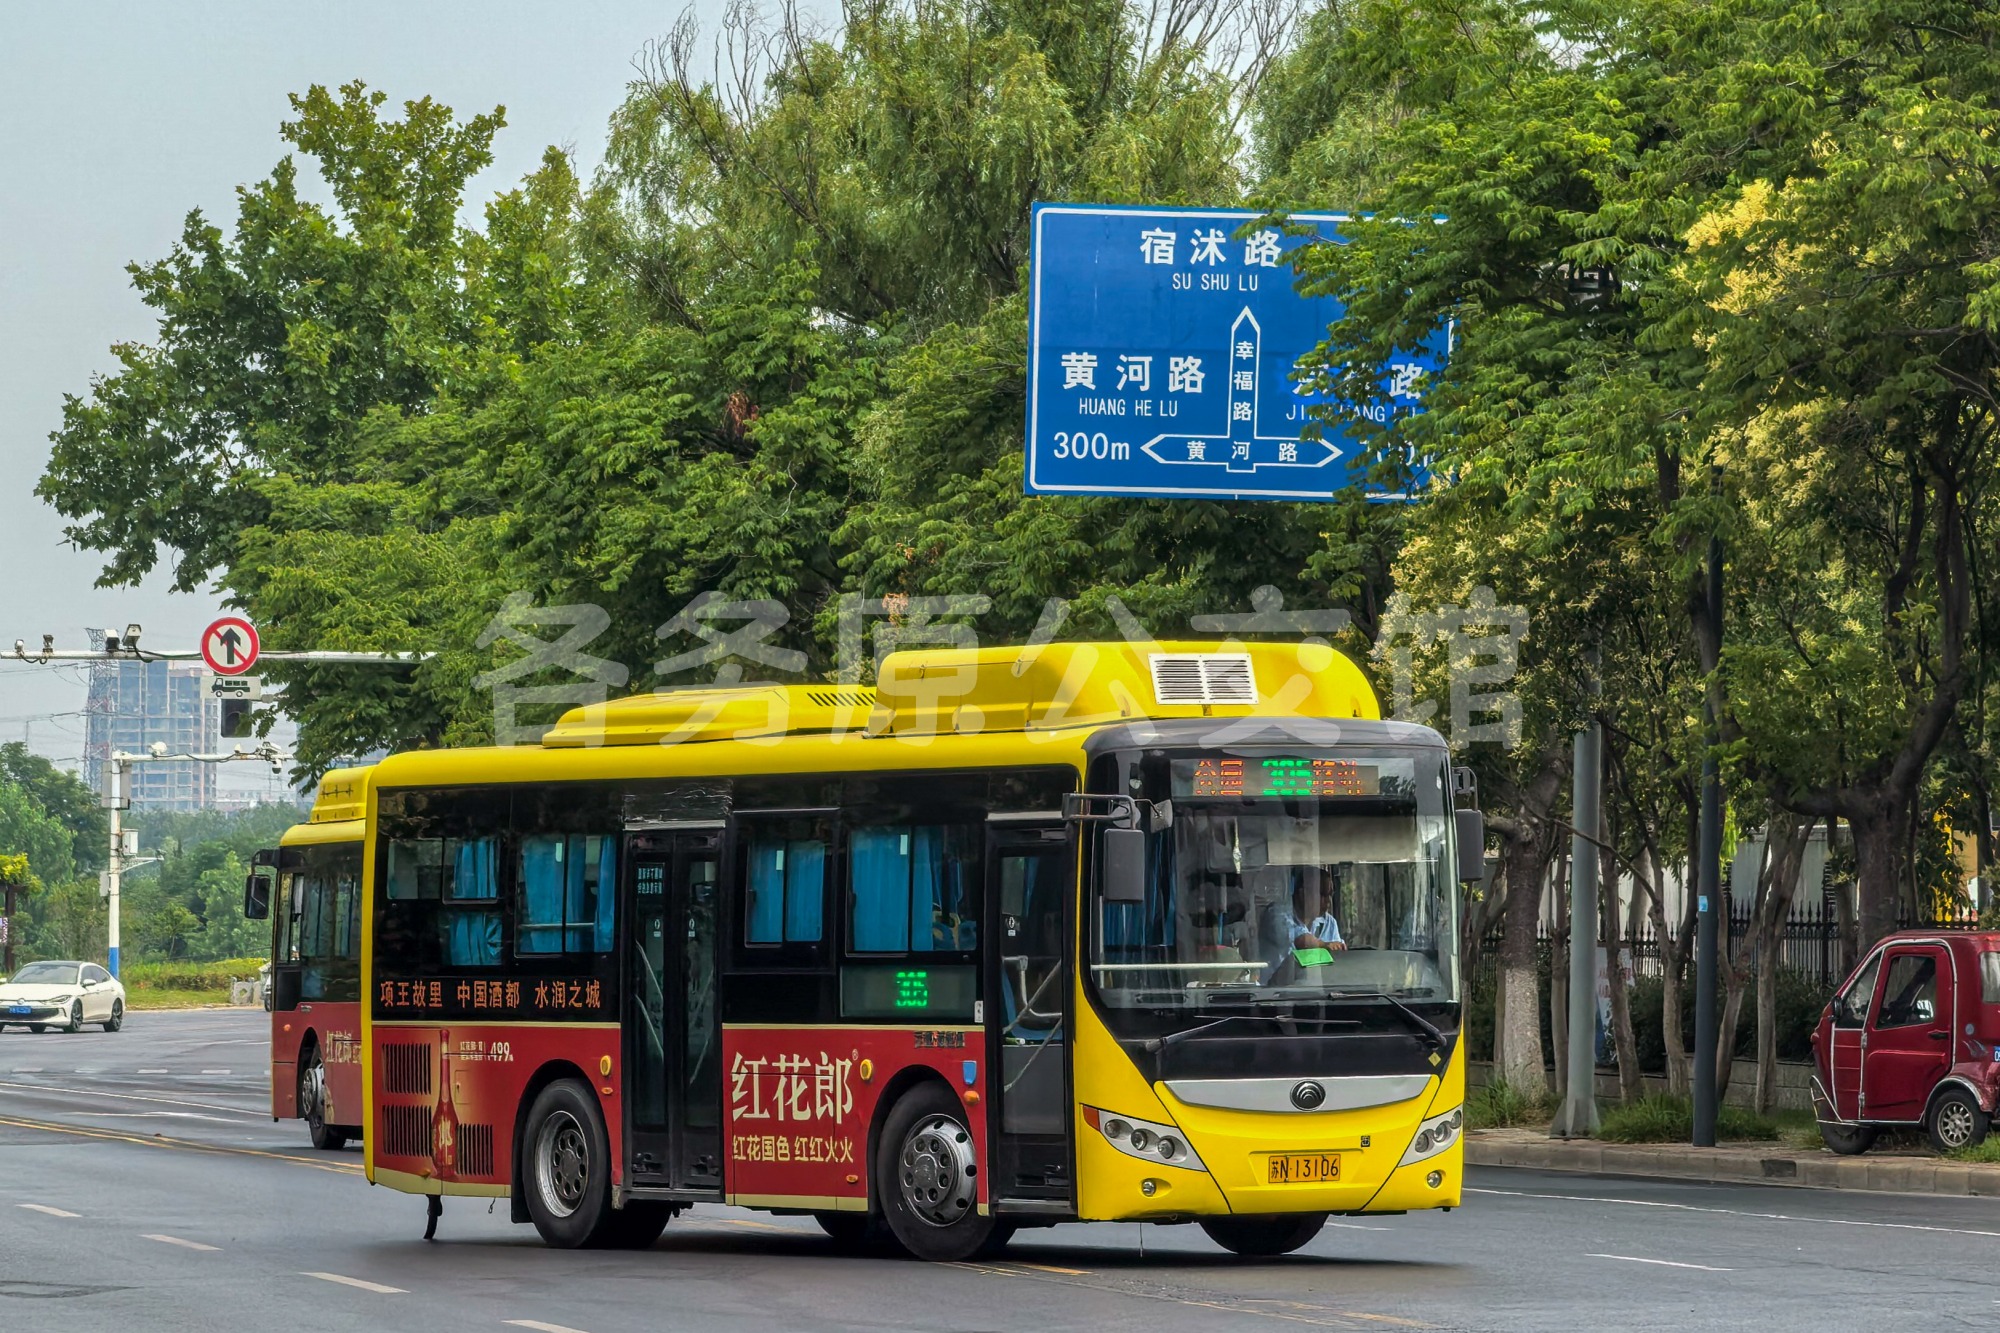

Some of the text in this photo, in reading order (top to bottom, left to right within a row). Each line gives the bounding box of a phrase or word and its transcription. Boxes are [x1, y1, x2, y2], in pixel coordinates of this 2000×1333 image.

[1139, 227, 1282, 267] 宿沭路
[1172, 273, 1258, 291] SU SHU LU
[1061, 352, 1205, 393] 黄河路
[1233, 341, 1255, 421] 幸福路
[1079, 397, 1178, 417] HUANG HE LU
[1053, 431, 1130, 460] 300m
[1187, 441, 1298, 462] 黄河路
[380, 979, 601, 1009] 项王故里 中国酒都 水润之城
[731, 1051, 853, 1125] 红花郎
[732, 1134, 854, 1163] 红花国色 红红火火
